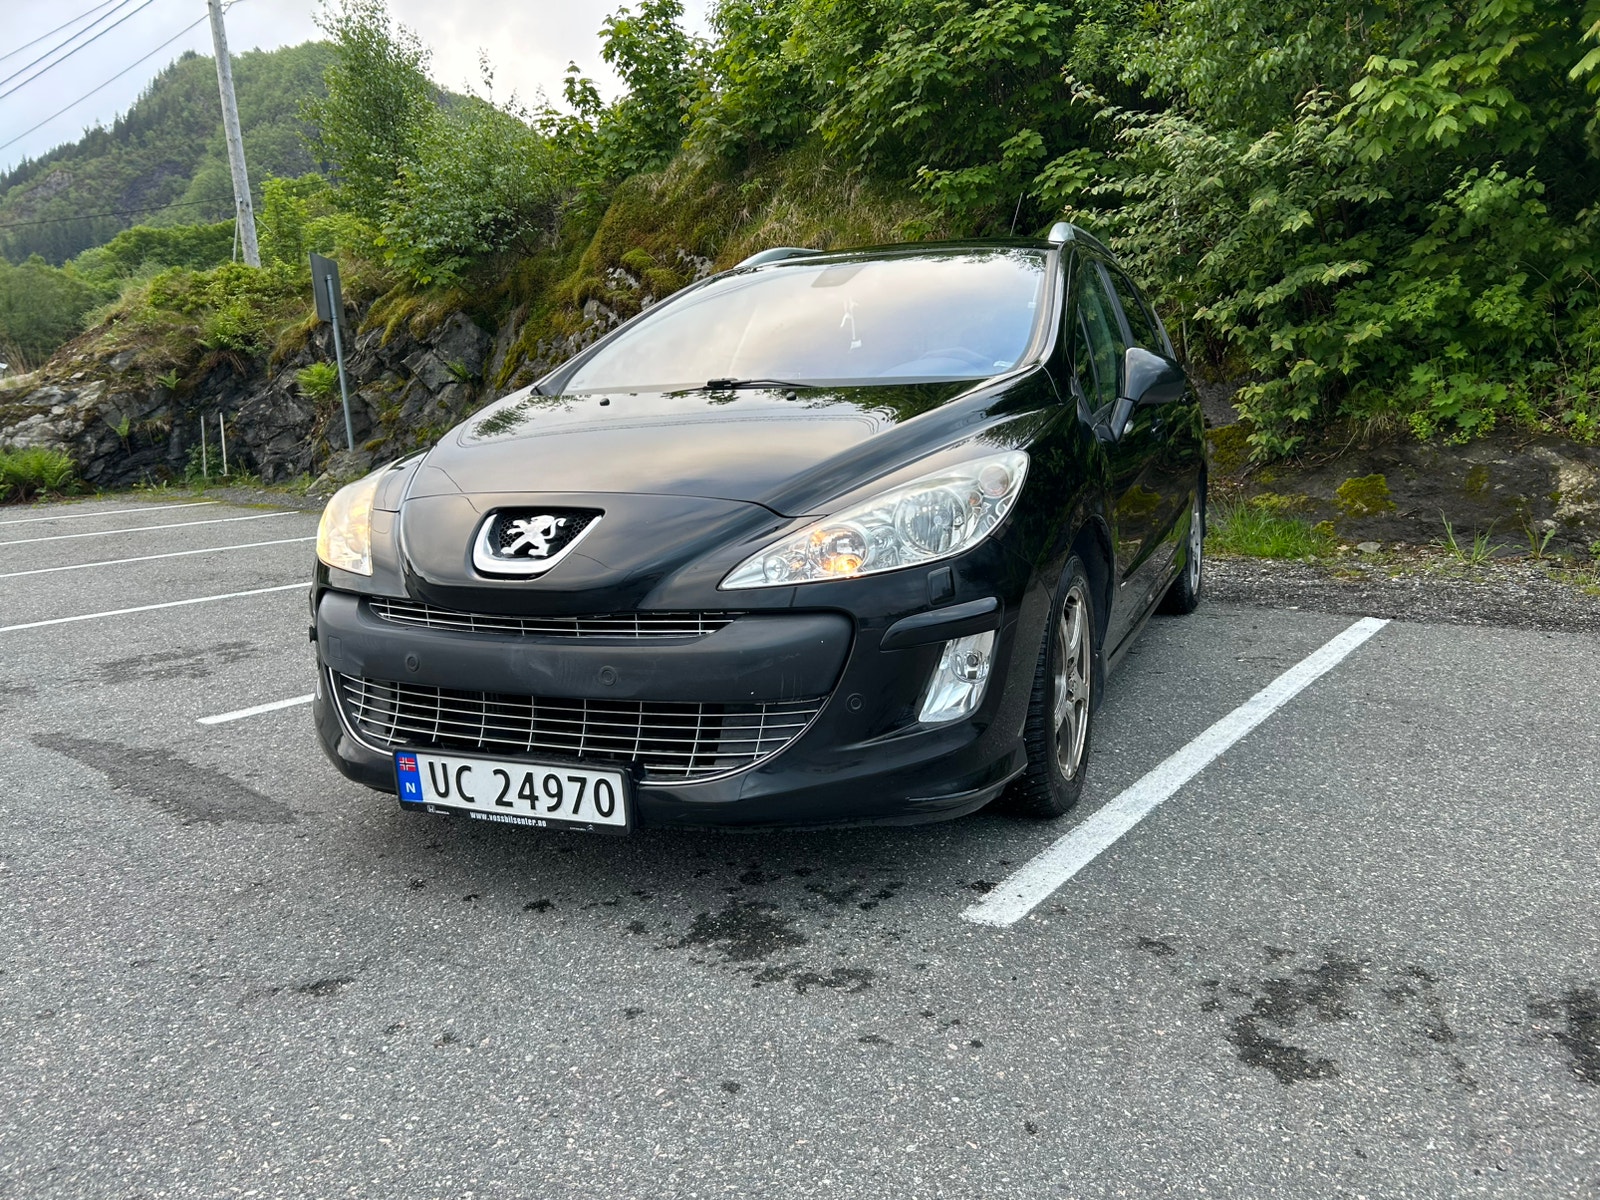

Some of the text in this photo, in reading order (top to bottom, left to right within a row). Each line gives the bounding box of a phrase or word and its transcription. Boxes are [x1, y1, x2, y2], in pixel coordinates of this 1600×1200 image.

[405, 782, 416, 794] N
[428, 761, 615, 818] UC 24970
[469, 811, 547, 827] www.vossbilsenter.no
